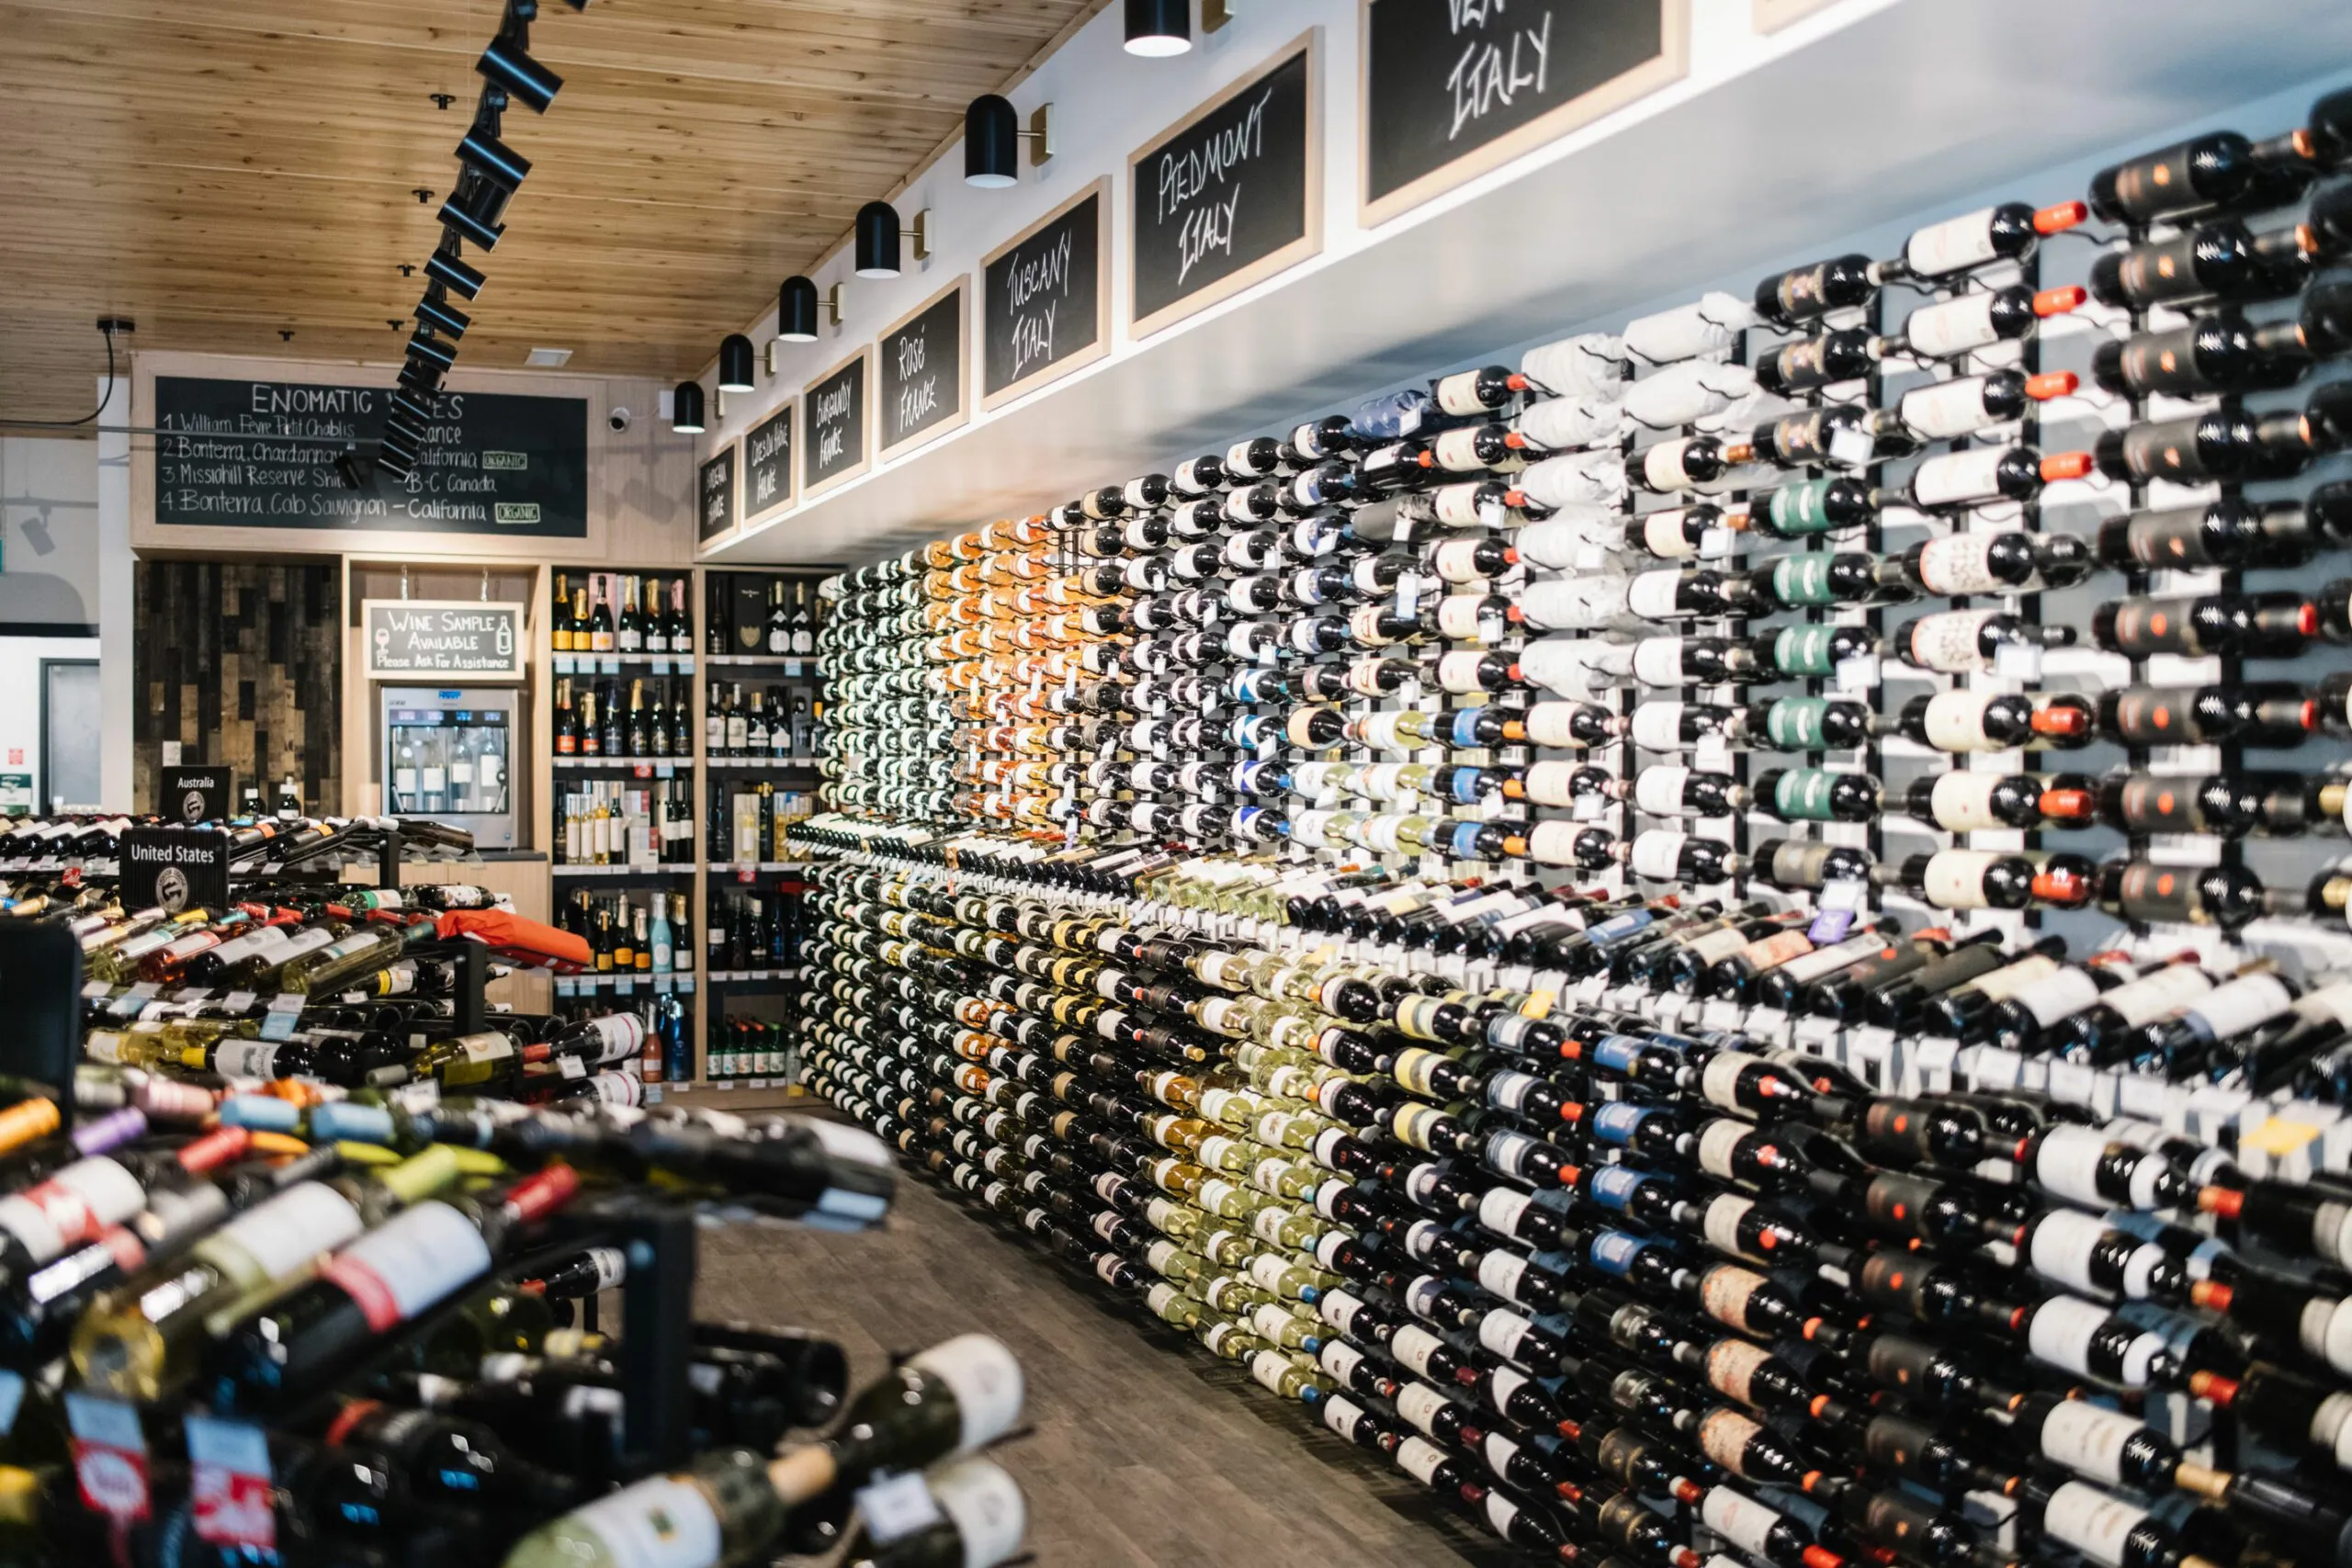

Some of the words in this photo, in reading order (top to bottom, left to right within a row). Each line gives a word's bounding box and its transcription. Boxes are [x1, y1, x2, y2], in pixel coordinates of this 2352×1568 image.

[1446, 10, 1552, 141] ITALY
[1159, 87, 1272, 225] PIEDMONT
[1178, 182, 1240, 286] ITALY
[1007, 228, 1071, 317] TUSCANY
[1012, 299, 1057, 381] ITALY
[252, 384, 372, 413] ENOMATIC
[899, 374, 937, 434] FRANCE
[180, 412, 233, 433] William
[306, 418, 356, 439] Chablis
[246, 464, 307, 486] Reserve
[447, 473, 498, 493] Canada
[270, 491, 307, 515] Cab
[311, 492, 388, 525] Sauvignon
[408, 497, 487, 522] California
[498, 505, 538, 522] ORGANIC
[388, 610, 434, 632] WINE
[441, 611, 496, 633] SAMPLE
[407, 631, 479, 650] AVAILABLE
[377, 654, 411, 668] Please
[414, 653, 435, 668] Ask
[435, 653, 450, 669] For
[453, 654, 510, 670] Assistance
[177, 776, 214, 788] Australia
[131, 843, 173, 862] United
[175, 844, 215, 863] States
